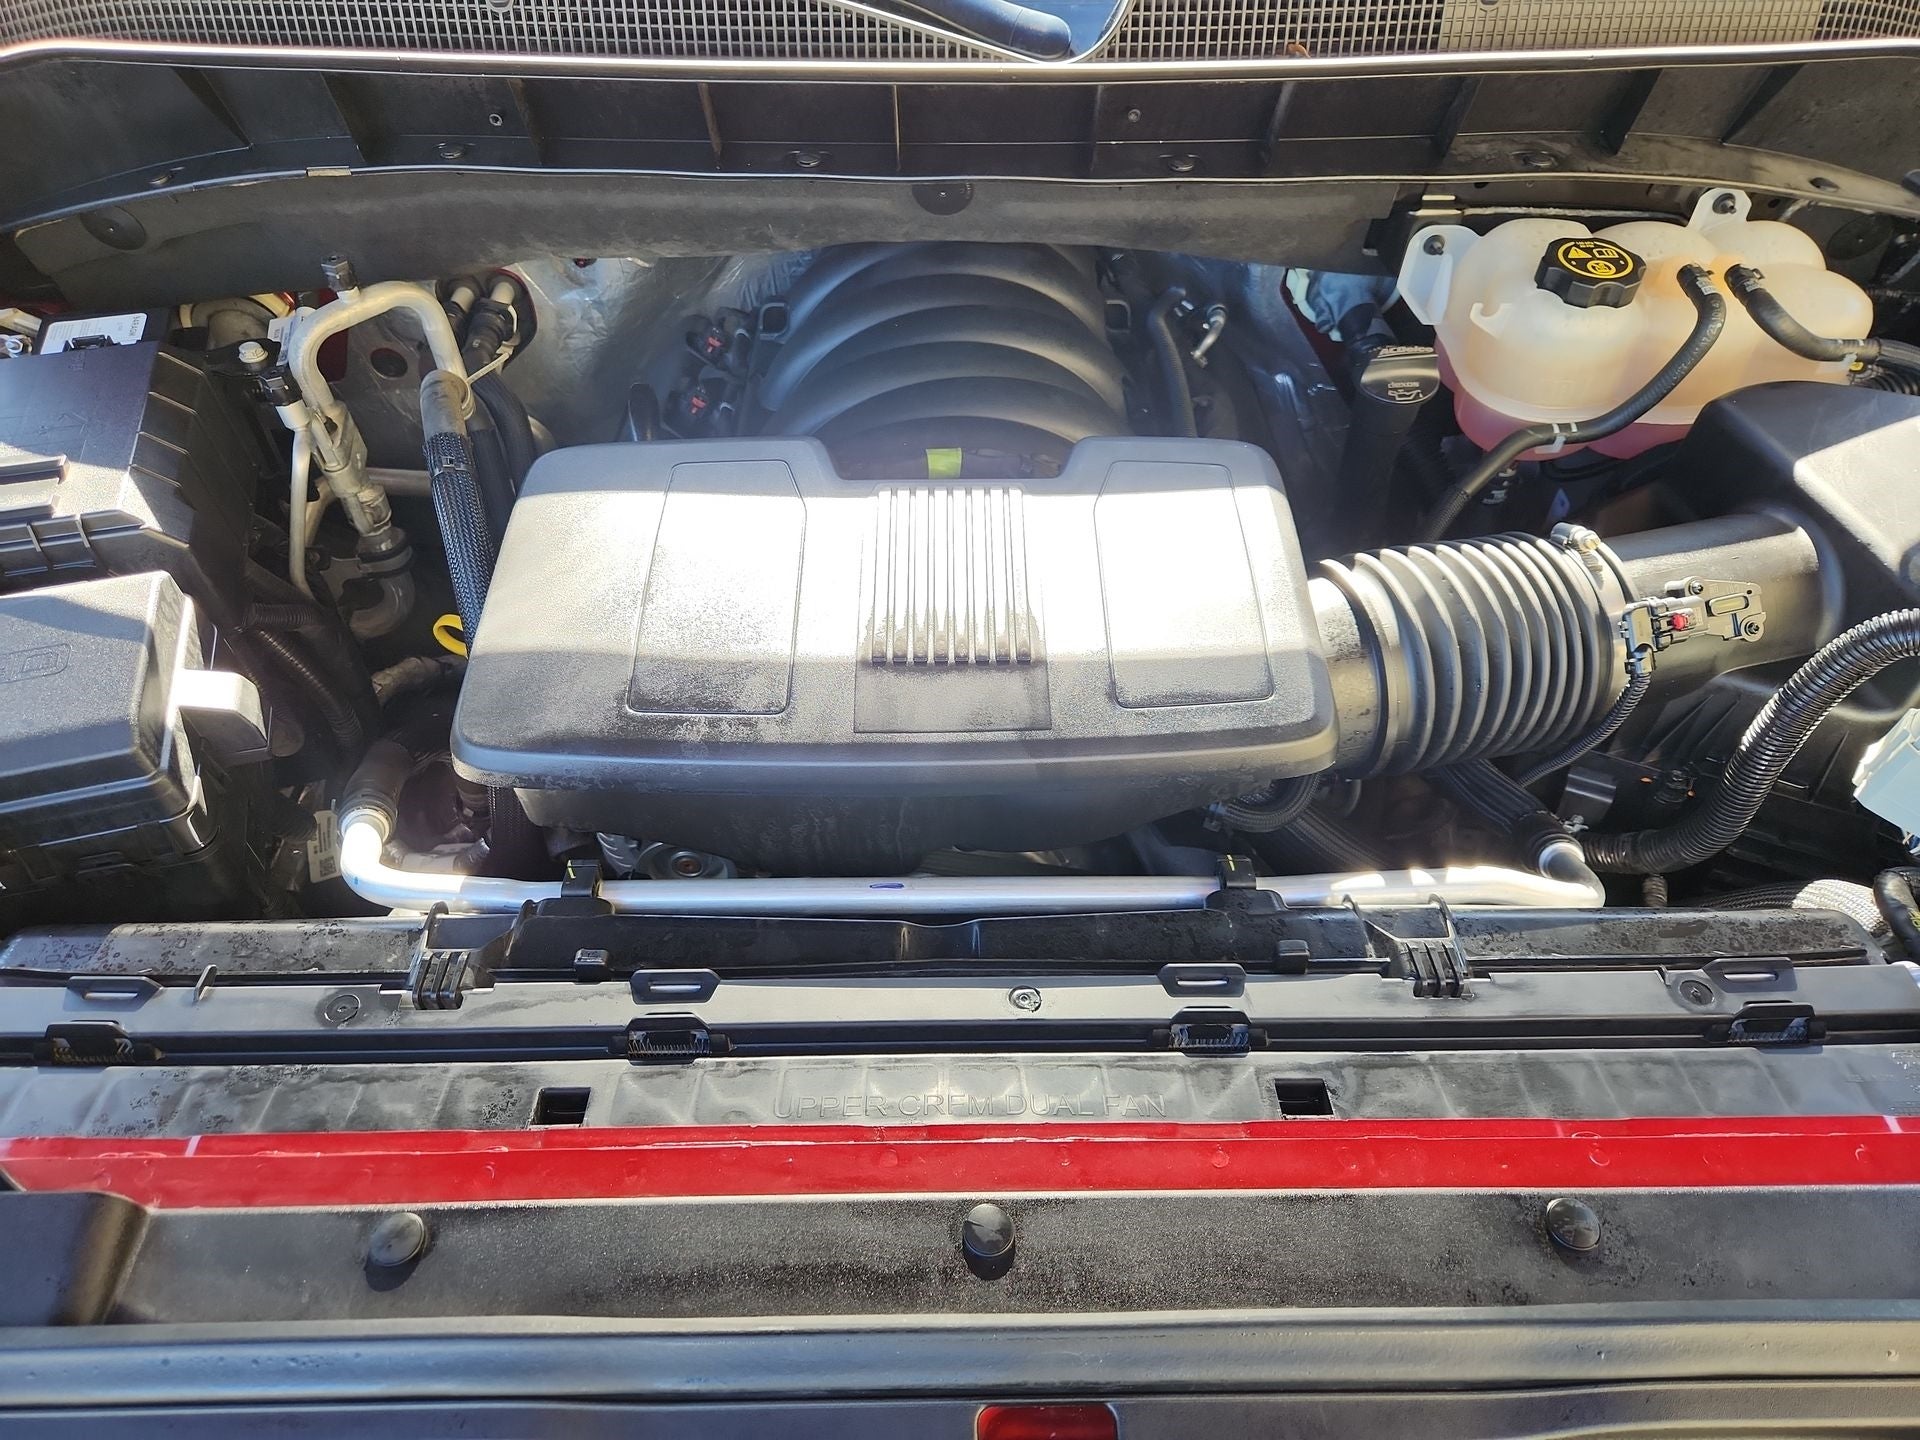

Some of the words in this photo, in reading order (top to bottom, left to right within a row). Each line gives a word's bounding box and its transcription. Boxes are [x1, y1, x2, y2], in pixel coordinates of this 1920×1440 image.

[773, 1094, 888, 1119] UPPER
[898, 1094, 994, 1116] CRFM
[1005, 1094, 1094, 1116] DUAL
[1102, 1094, 1167, 1117] FAN
